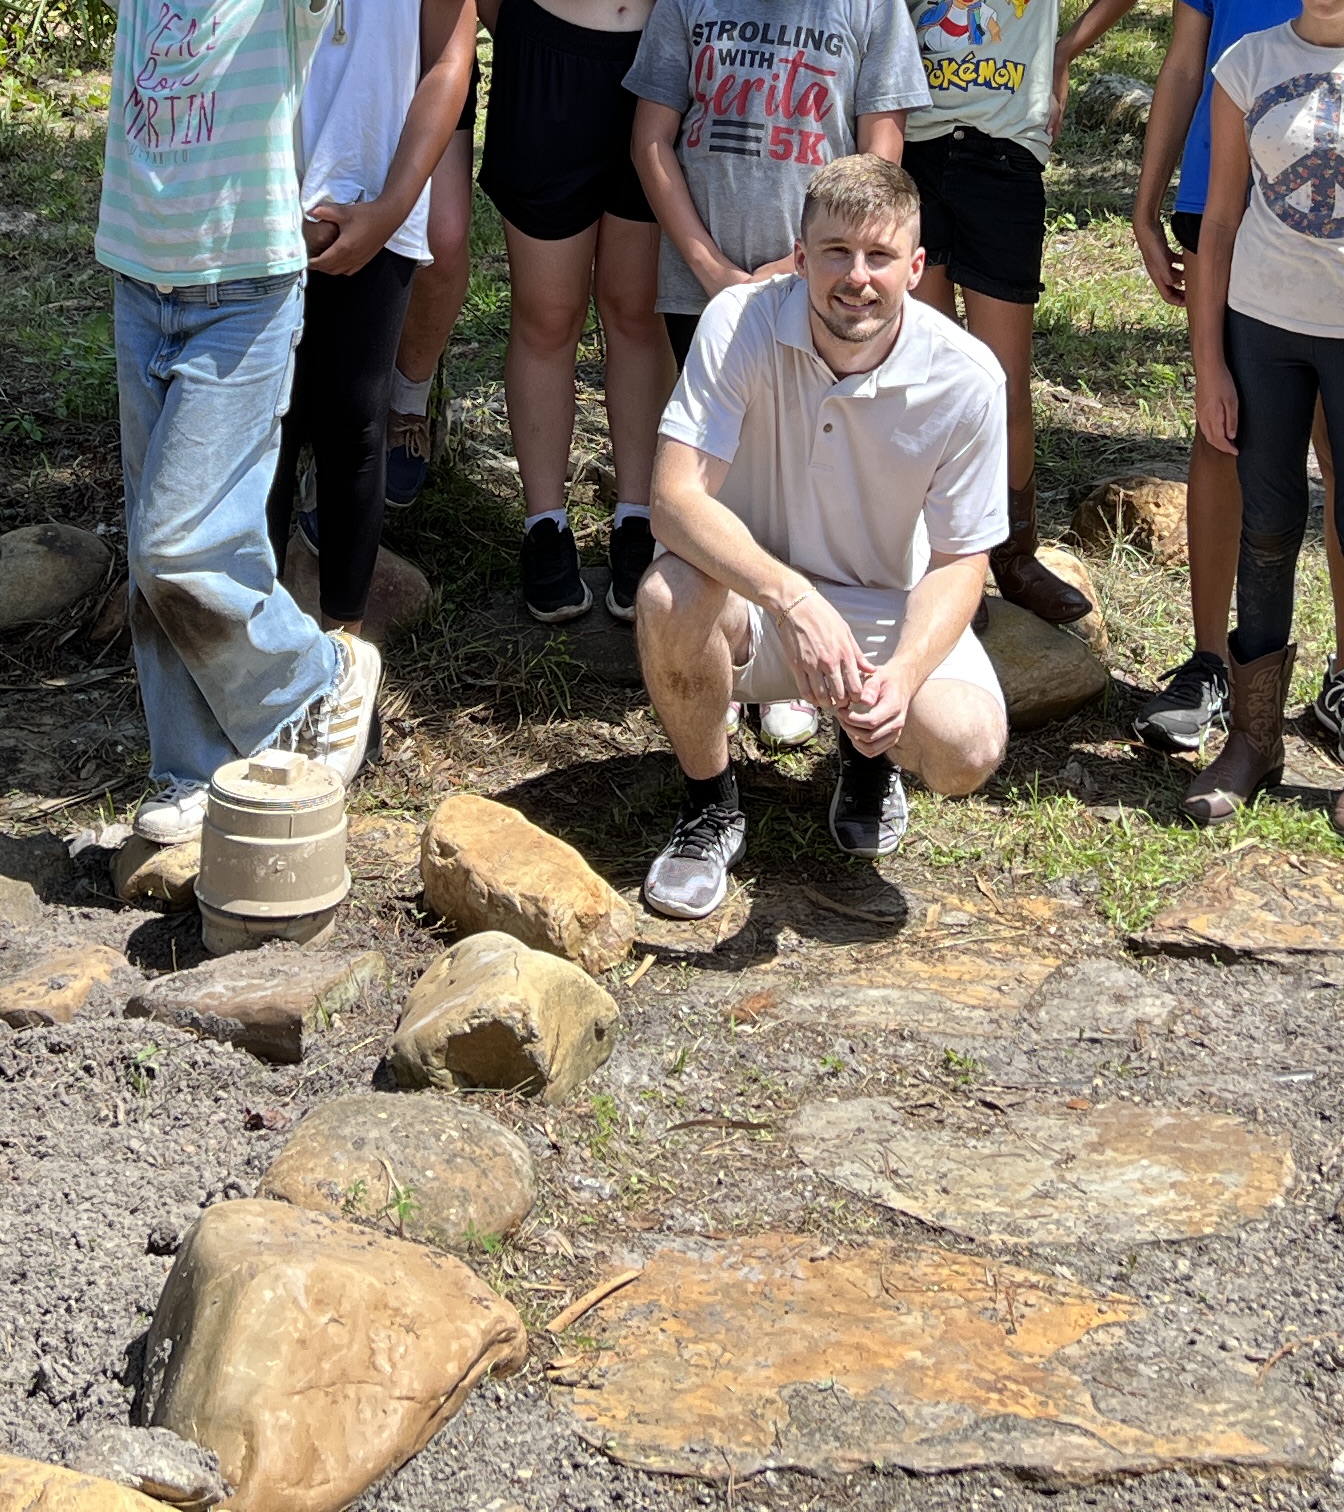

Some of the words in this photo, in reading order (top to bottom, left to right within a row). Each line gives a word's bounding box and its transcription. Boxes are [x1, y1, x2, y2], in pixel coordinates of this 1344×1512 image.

[692, 20, 844, 58] STROLLING
[718, 48, 775, 69] WITH
[768, 125, 827, 166] 5K
